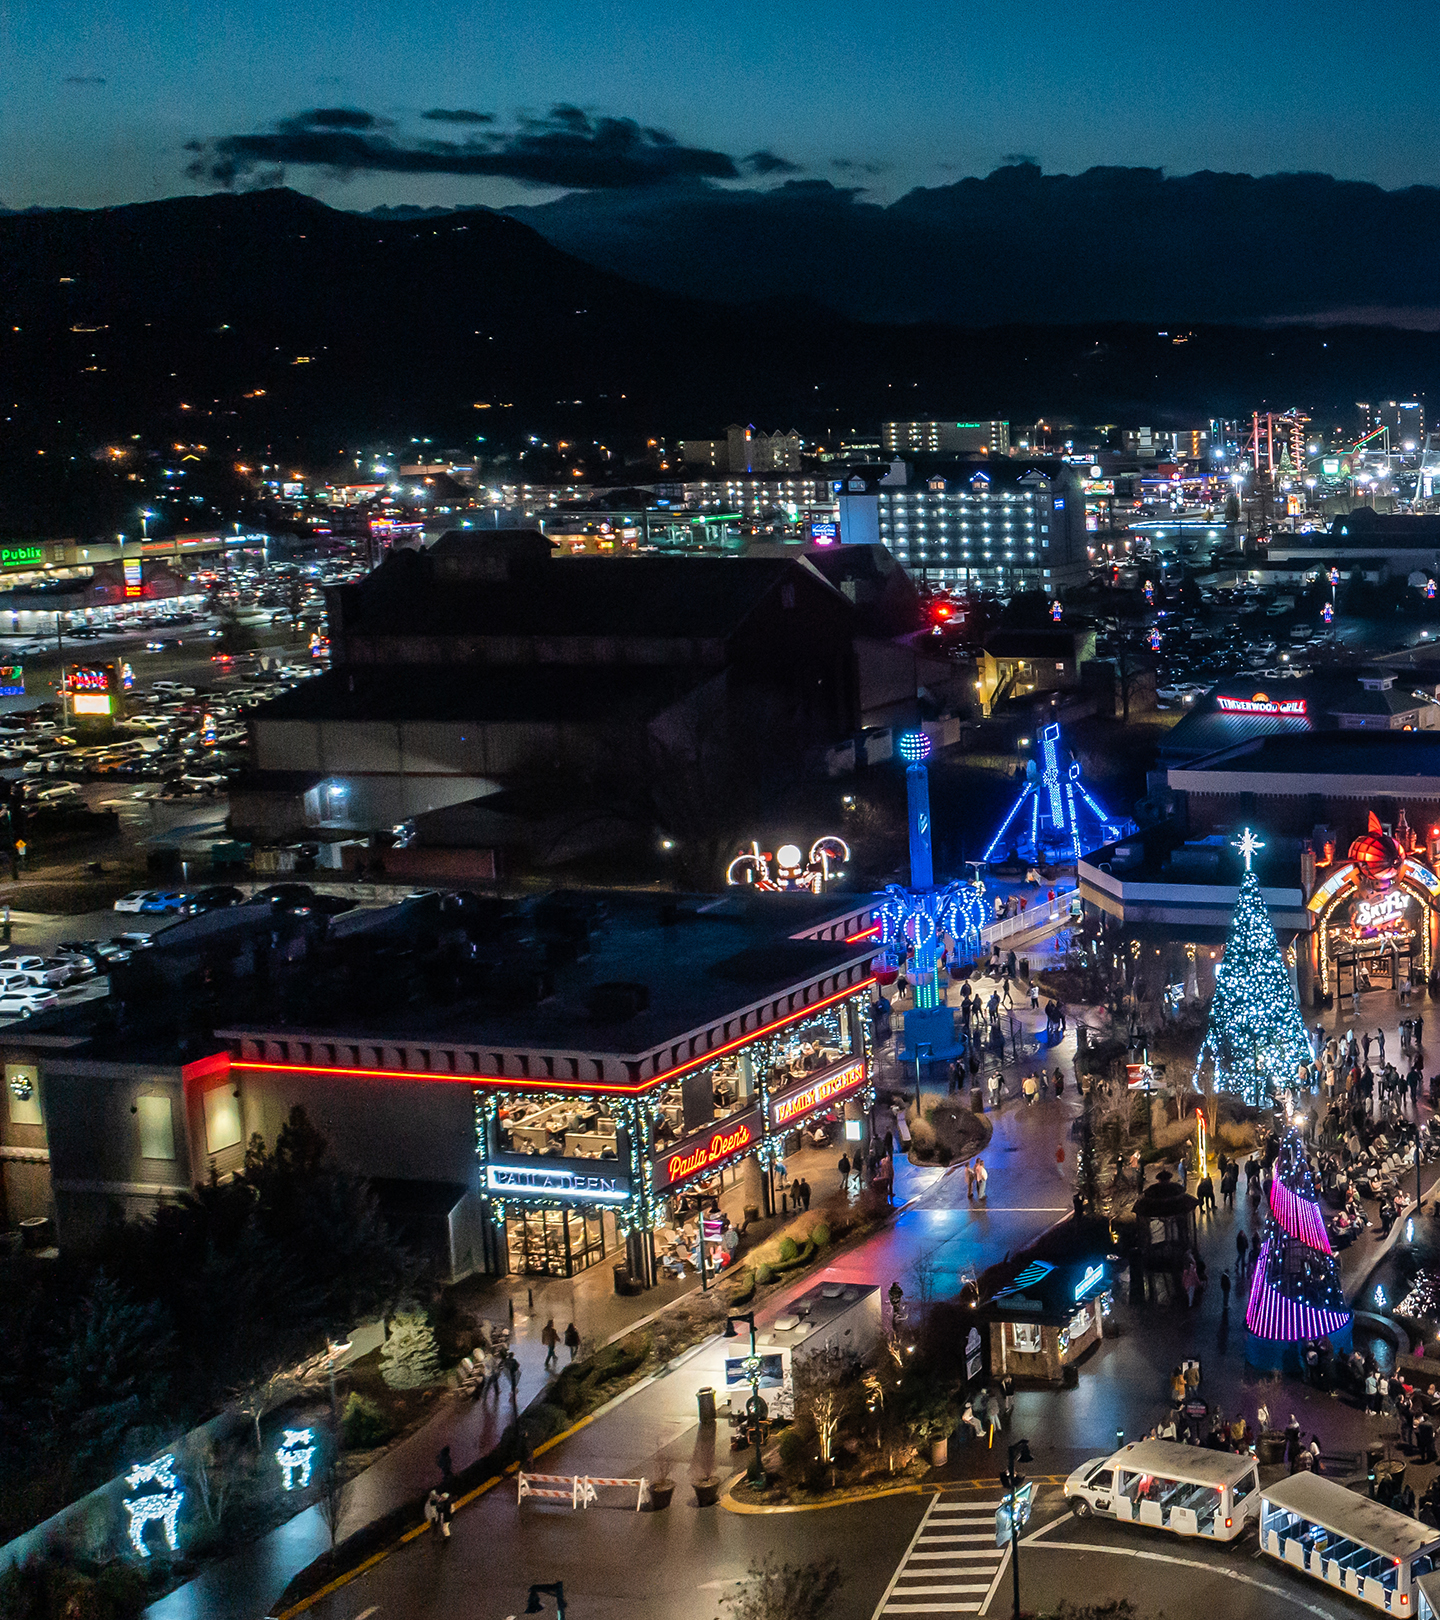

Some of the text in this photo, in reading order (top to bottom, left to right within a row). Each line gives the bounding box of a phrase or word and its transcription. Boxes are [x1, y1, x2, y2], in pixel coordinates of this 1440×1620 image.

[2, 547, 41, 560] Publix
[67, 674, 108, 688] PIRATES
[1217, 698, 1304, 713] TIMBERWOOD GRILL
[776, 1064, 864, 1123] FAMILY KITCHEN
[669, 1124, 751, 1182] Paula Deen's
[497, 1170, 617, 1192] PAULA DEEN
